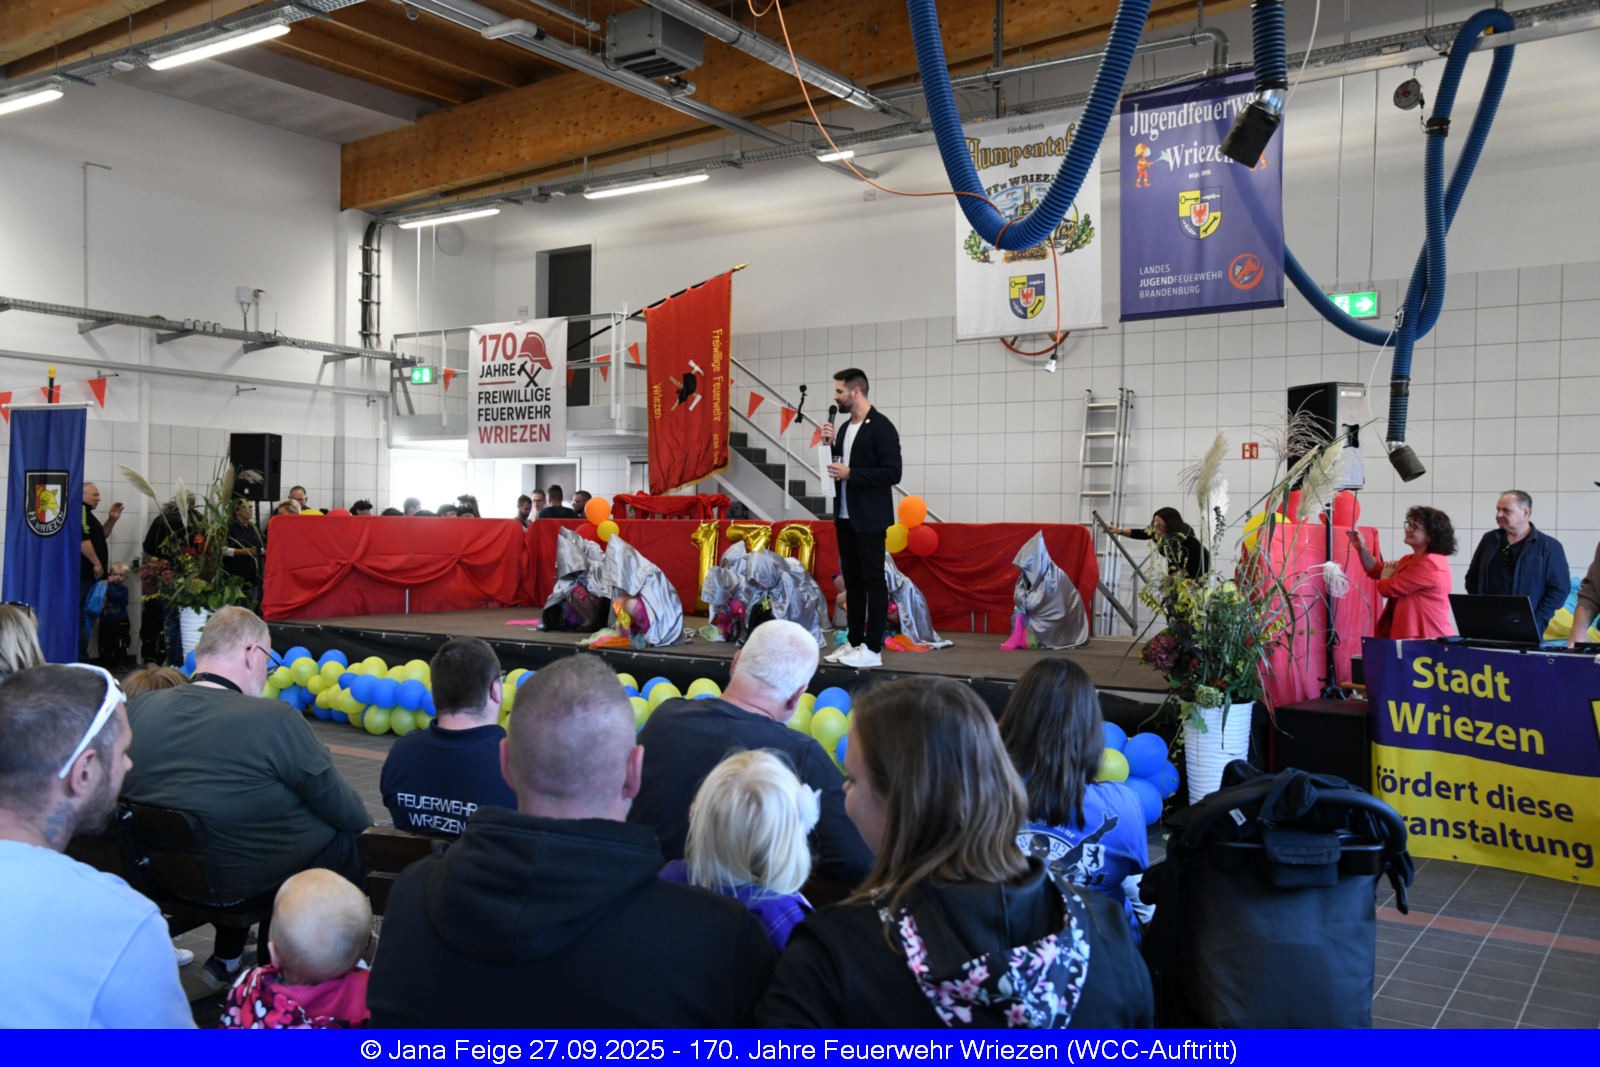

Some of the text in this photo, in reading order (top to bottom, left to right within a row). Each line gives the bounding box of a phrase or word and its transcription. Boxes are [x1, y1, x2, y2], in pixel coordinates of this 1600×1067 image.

[1007, 122, 1045, 134] Förderkreis
[1130, 92, 1255, 141] Jugendfeuerwe
[966, 122, 1076, 171] Humpentaf
[1008, 173, 1058, 188] WRIEZ
[1139, 264, 1170, 275] LANDES
[1139, 270, 1223, 287] JUGENDFEUERWEHR
[1139, 285, 1200, 299] BRANDENBURG
[478, 332, 517, 362] 170
[711, 328, 723, 374] Freiwillige
[479, 363, 516, 379] JAHRE
[477, 387, 551, 405] FREIWILLIGE
[652, 383, 662, 420] Wriezen
[712, 376, 724, 422] Feuerwehr
[477, 404, 551, 422] FEUERWEHR
[478, 423, 550, 444] WRIEZEN
[1412, 656, 1511, 702] Stadt
[1388, 700, 1545, 755] Wriezen
[397, 792, 479, 817] FEUERWEHR
[1486, 783, 1574, 823] diese
[408, 812, 467, 835] WRIEZEN
[1401, 815, 1594, 869] ranstaltung
